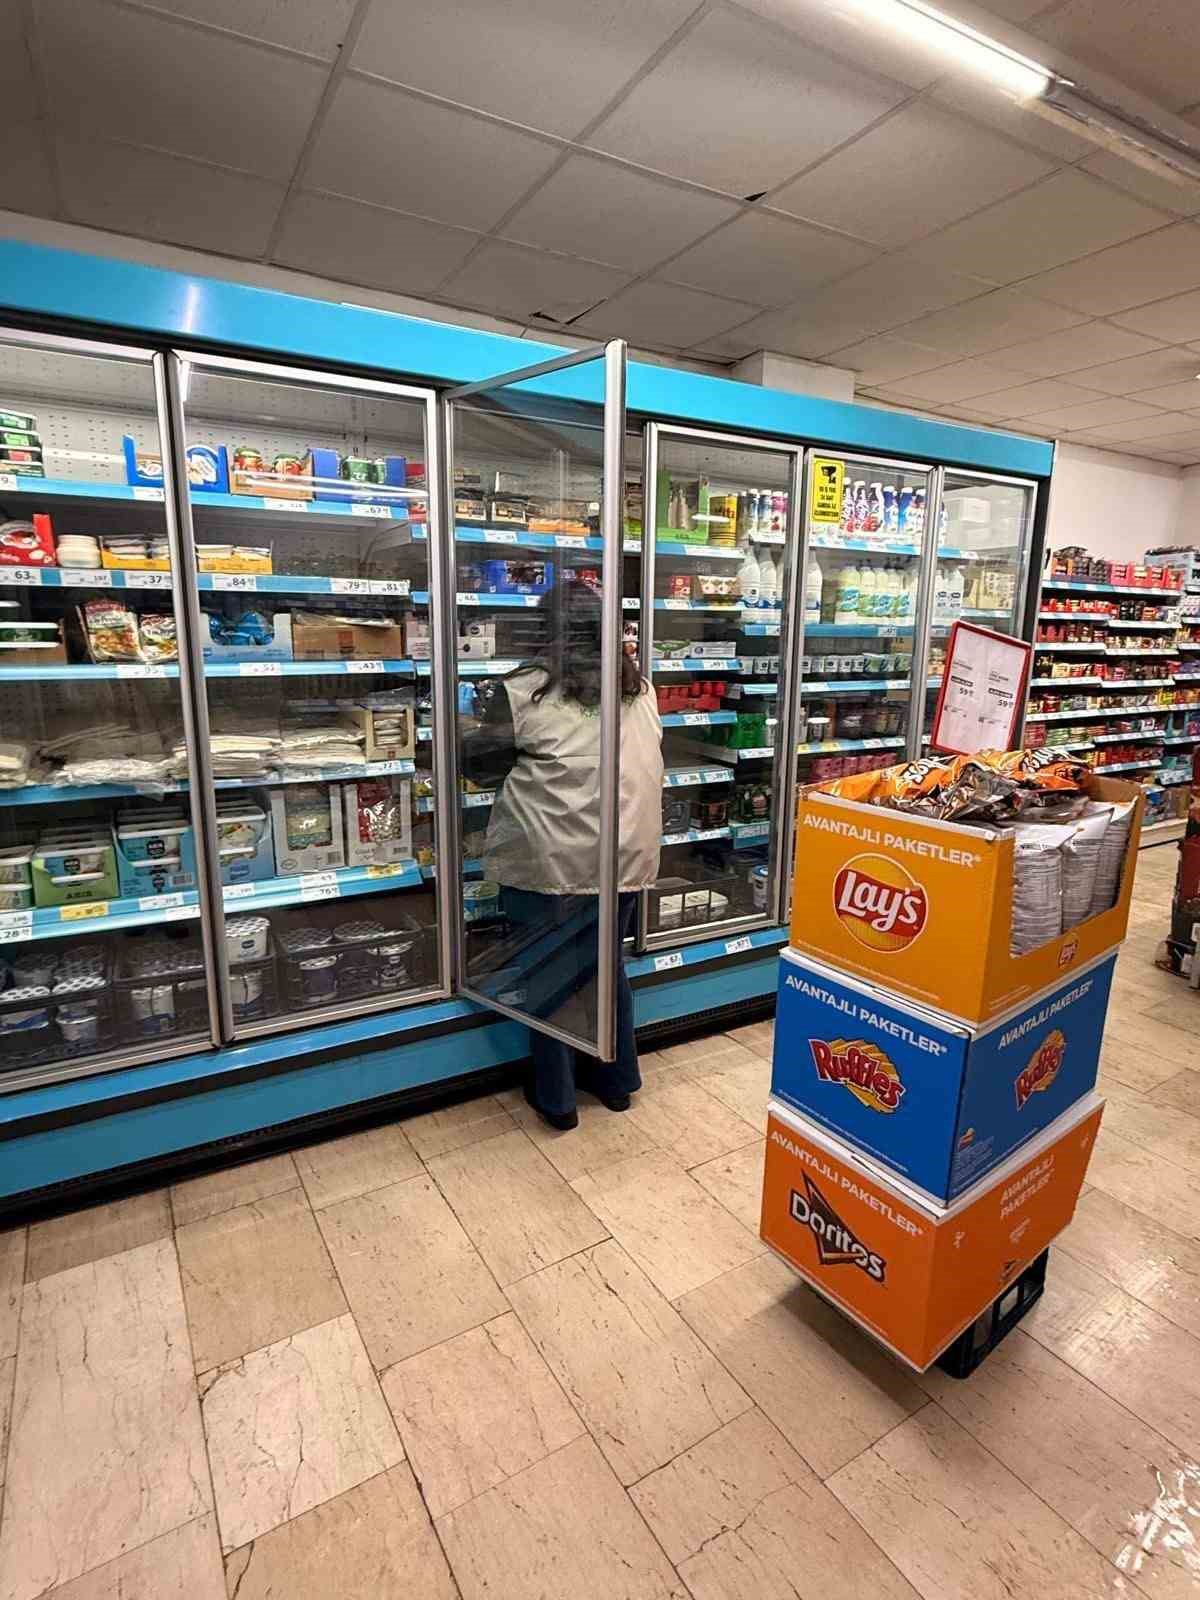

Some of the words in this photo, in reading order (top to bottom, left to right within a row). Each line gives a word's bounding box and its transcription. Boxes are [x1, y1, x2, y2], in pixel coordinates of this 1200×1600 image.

[15, 571, 31, 580] 63
[150, 575, 162, 584] 37
[232, 577, 246, 586] 84
[802, 813, 882, 844] AVANTAJLI
[837, 869, 922, 932] Lay's
[785, 974, 857, 1018] AVANTAJLI
[998, 1007, 1050, 1051] AVANTAJLI
[808, 1040, 906, 1109] Ruffles
[770, 1131, 839, 1185] AVANTAJLI
[791, 1191, 887, 1281] Doritos
